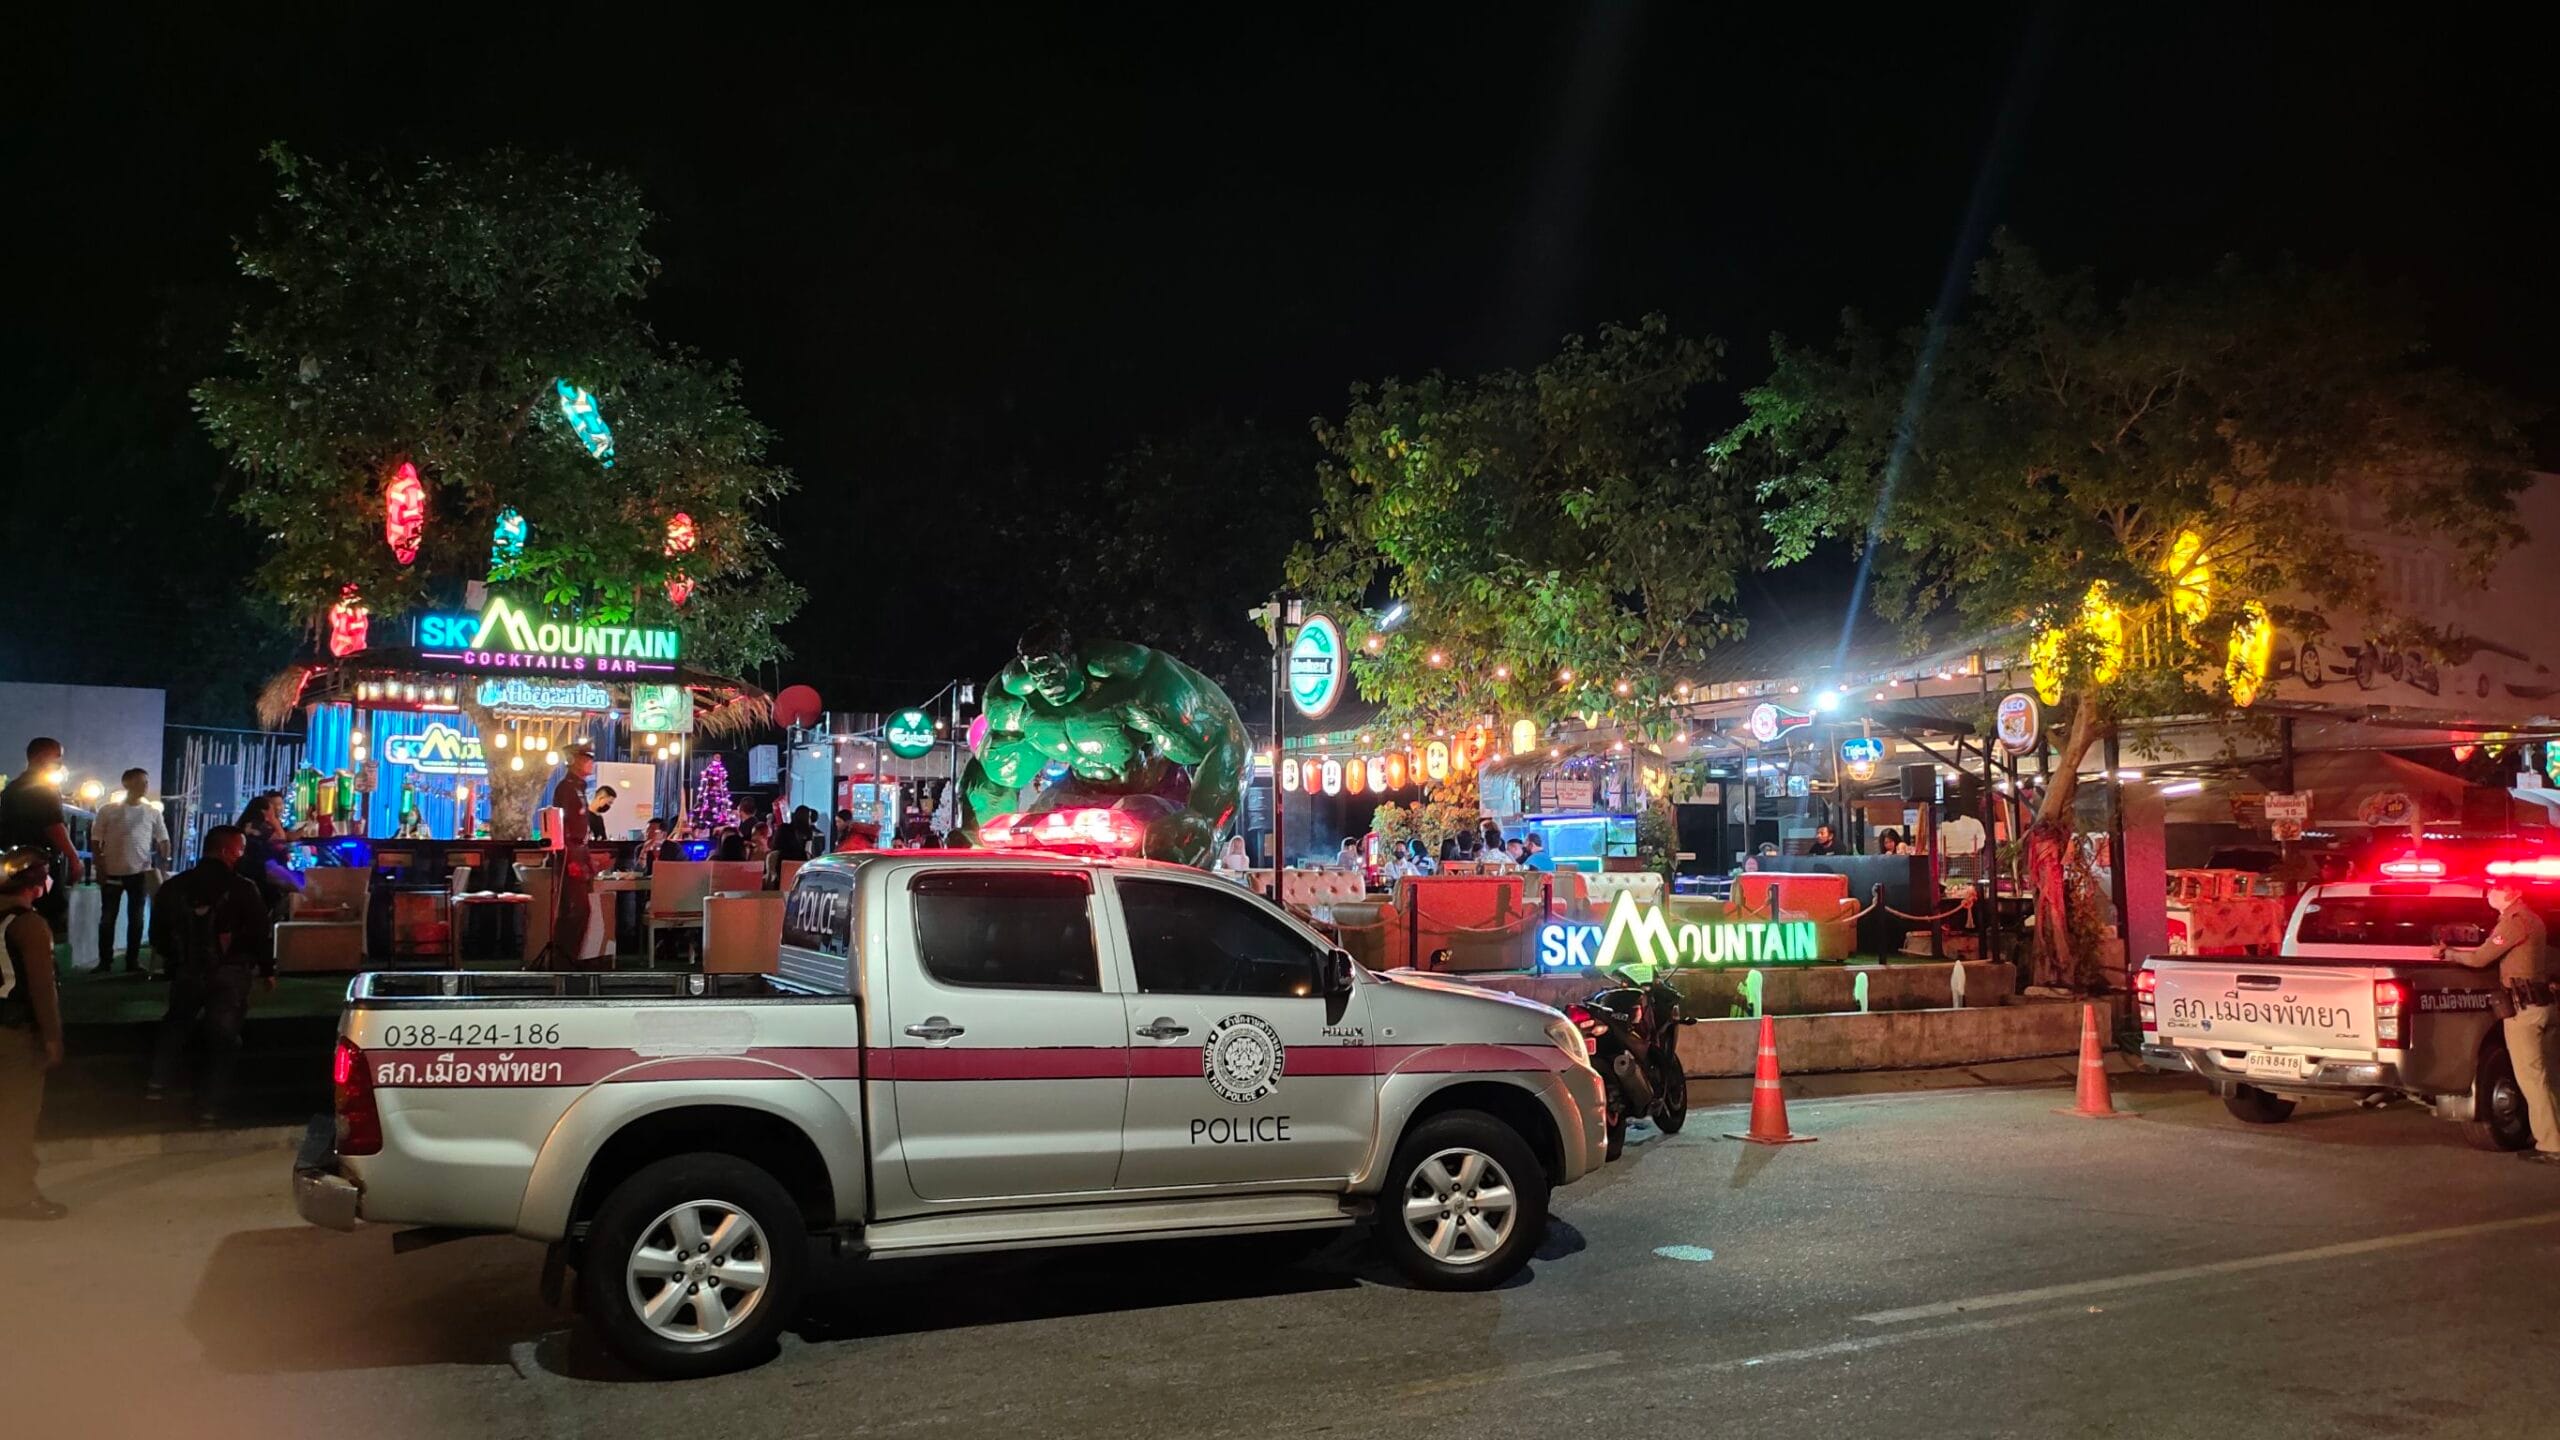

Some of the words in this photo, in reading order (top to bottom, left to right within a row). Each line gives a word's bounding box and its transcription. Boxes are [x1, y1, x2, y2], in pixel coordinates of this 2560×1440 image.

[471, 597, 676, 660] MOUNTAIN
[464, 652, 585, 670] COCKTAILS
[597, 661, 637, 673] BAR
[1845, 745, 1868, 760] Tiger
[796, 890, 839, 935] POLICE
[1594, 889, 1818, 967] MOUNTAIN
[2173, 990, 2351, 1029] สภ.เมืองพัทยา
[385, 1023, 560, 1047] 038-424-186
[1322, 1027, 1364, 1038] HILUX
[377, 1053, 562, 1084] สภ.เมืองพัทยา
[1204, 1042, 1215, 1075] ROYAL
[1209, 1075, 1226, 1097] THAI
[1225, 1091, 1258, 1102] POLICE
[1191, 1116, 1291, 1145] POLICE
